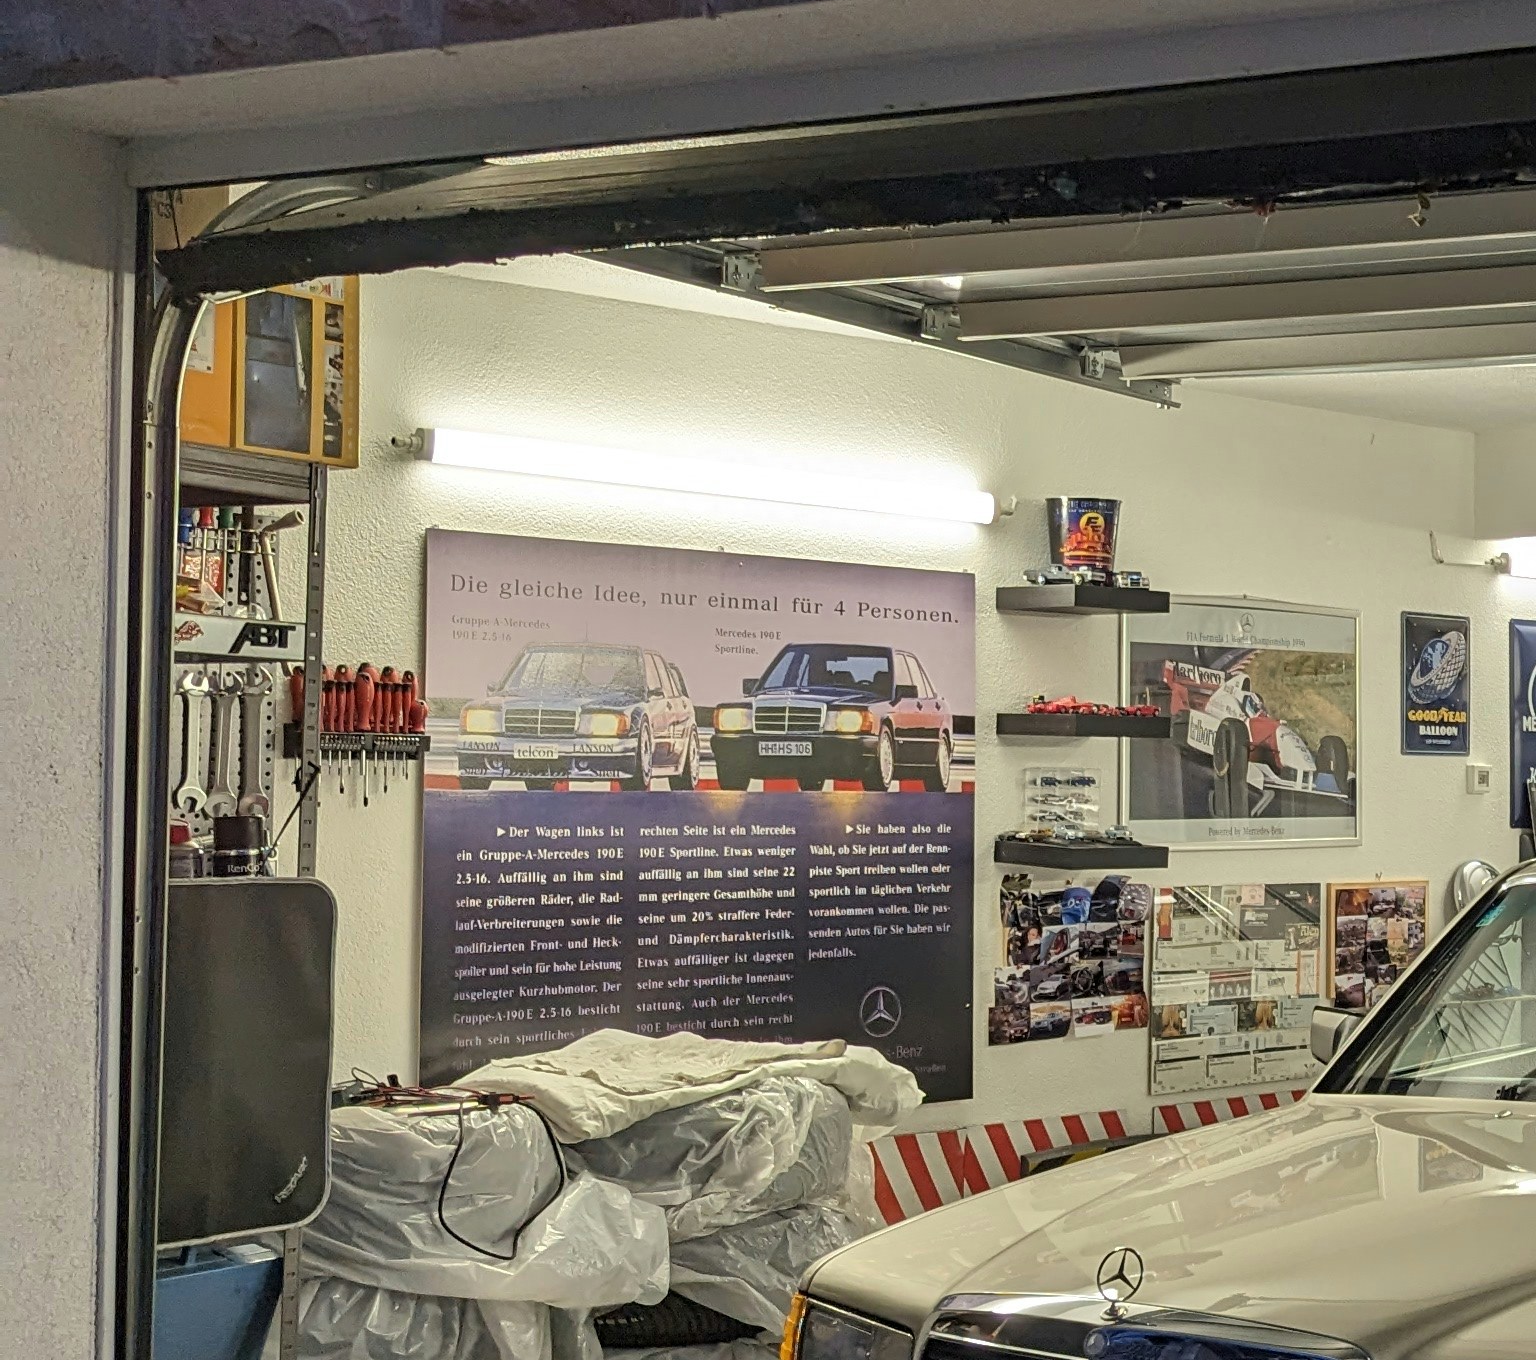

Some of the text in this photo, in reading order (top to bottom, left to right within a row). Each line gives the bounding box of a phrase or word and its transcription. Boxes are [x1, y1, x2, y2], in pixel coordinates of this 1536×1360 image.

[451, 574, 959, 623] Die gleiche Idee, nur einmal für 4 Personen.
[228, 622, 296, 654] ABT
[715, 628, 756, 639] Mercedes
[715, 644, 758, 655] Sportline.
[1419, 726, 1458, 736] BALLOON
[518, 747, 554, 758] telcon
[509, 826, 624, 839] Der Wagen links ist
[640, 825, 796, 836] rechten Seite ist ein Mercedes
[856, 824, 951, 835] Sie haben also die
[457, 850, 472, 861] ein
[480, 849, 589, 863] Gruppe-A-Mercedes
[670, 847, 719, 860] Sportline.
[724, 846, 752, 857] Etwas
[758, 845, 796, 859] weniger
[810, 843, 951, 856] Wahl, ob Sie jetzt auf der Renn-
[457, 870, 623, 885] 2.5-16. Auffällig an ihm sind
[639, 867, 795, 881] auffällig an ihm sind seine 22
[809, 863, 951, 878] piste Sport treiben wollen oder
[639, 887, 795, 904] mm geringere Gesamthöhe und
[809, 883, 951, 898] sportlich im täglichen Verkehr
[456, 893, 623, 909] seine größeren Räder, die Rad-
[455, 915, 622, 931] lauf-Verbreiterungen sowie die
[638, 909, 795, 924] seine um 20% straffere Feder-
[638, 929, 795, 946] und Dämpfercharakteristik.
[809, 947, 856, 961] jedenfalls.
